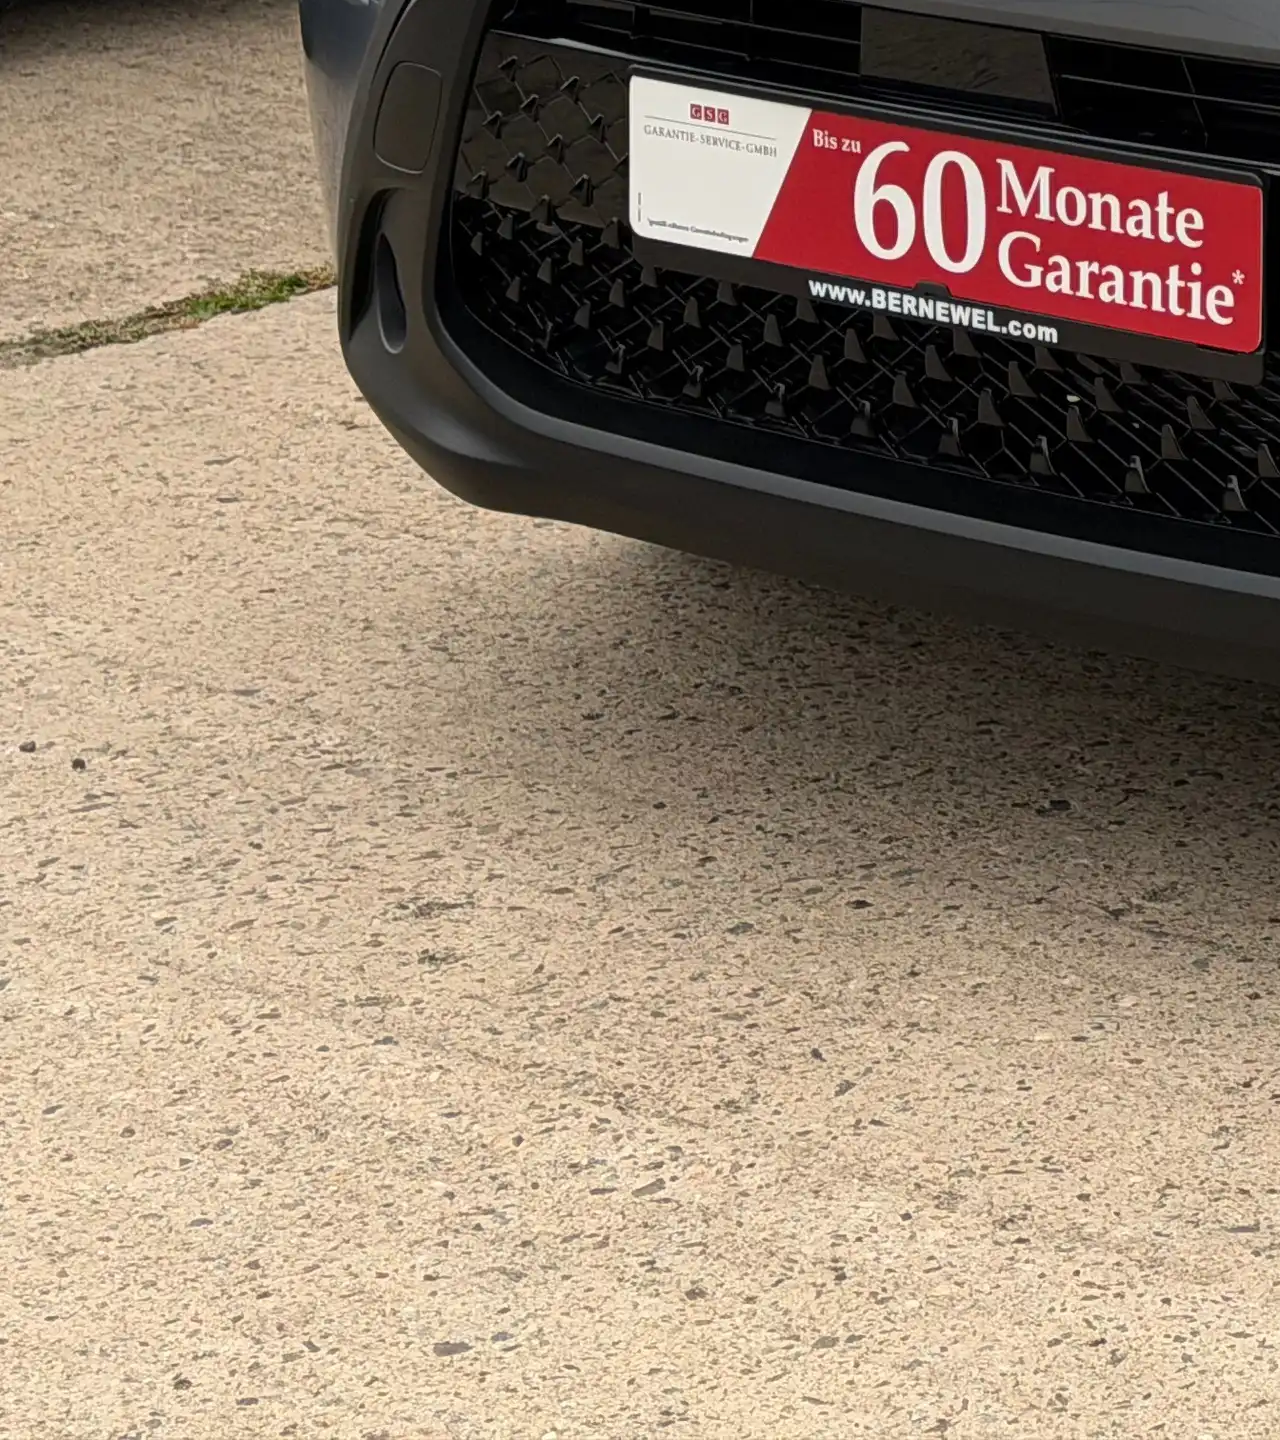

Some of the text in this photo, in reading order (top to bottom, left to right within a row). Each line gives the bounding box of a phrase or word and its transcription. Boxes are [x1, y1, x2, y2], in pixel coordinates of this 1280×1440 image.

[812, 128, 862, 154] Bis zu
[853, 140, 987, 274] 60
[996, 158, 1205, 249] Monate
[808, 279, 1059, 343] www.BERNEWEL.com
